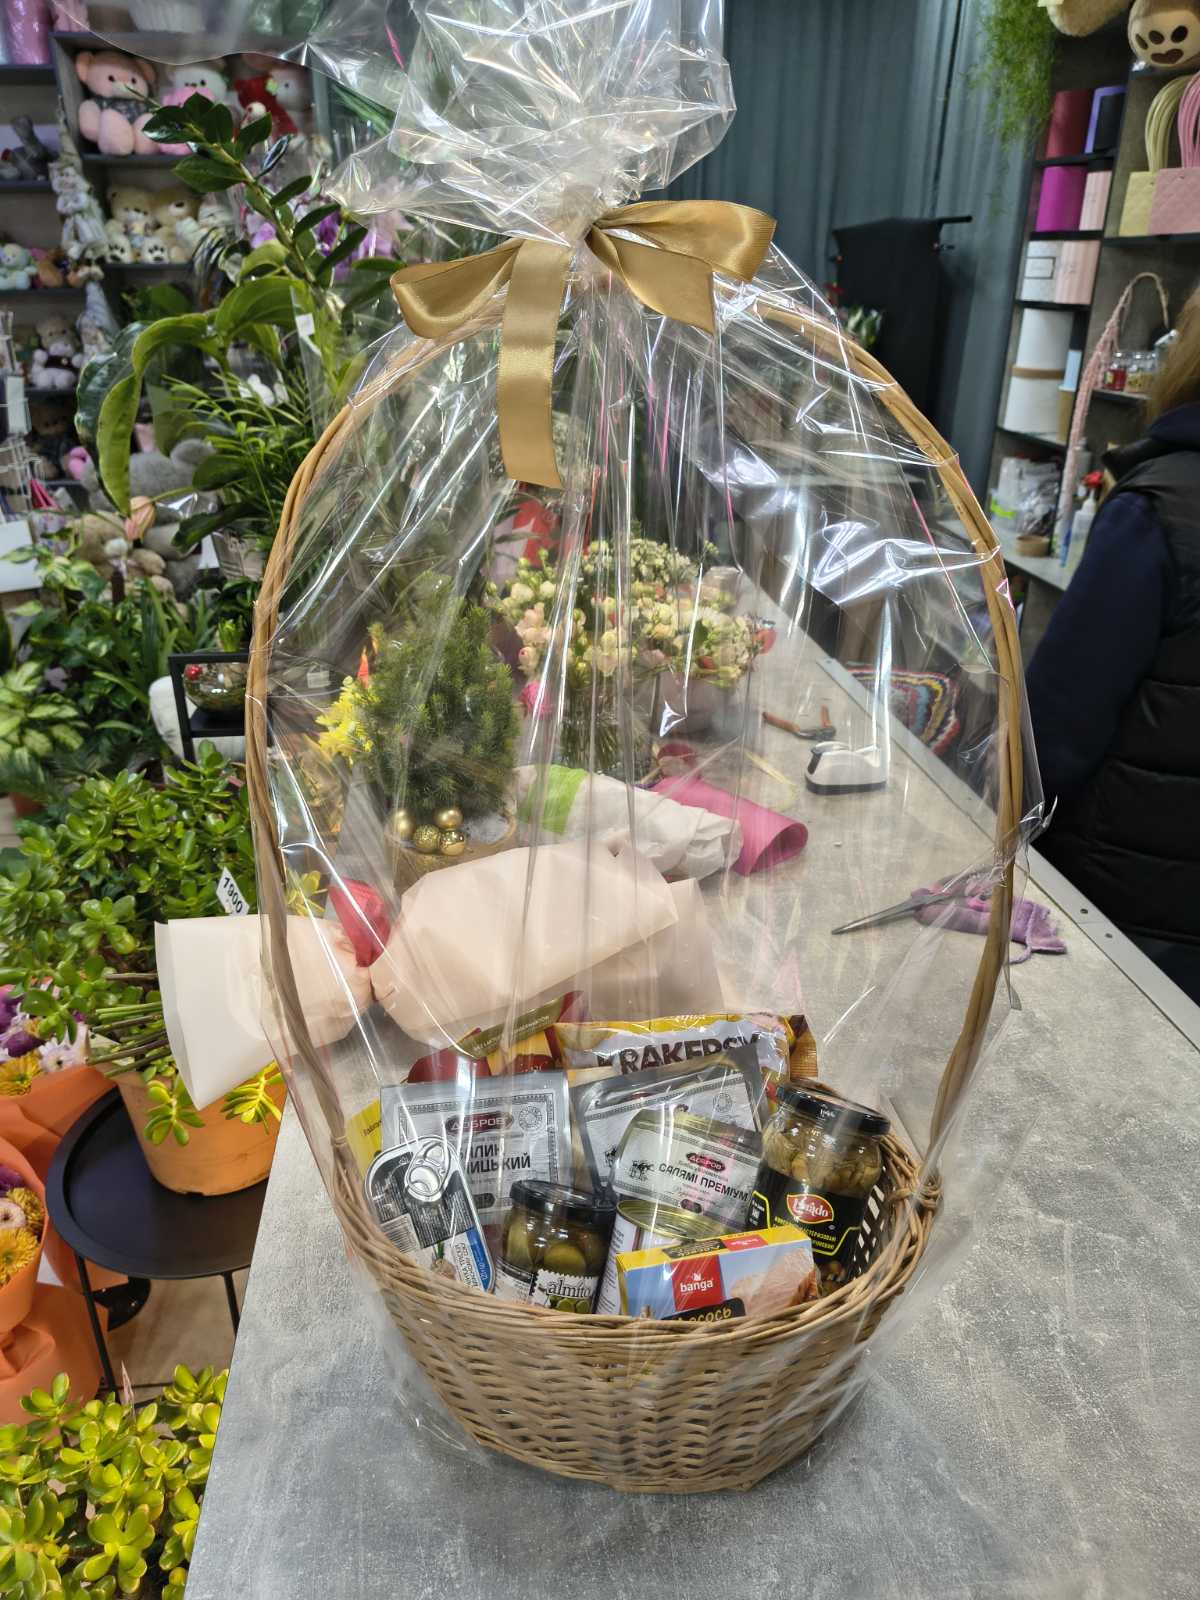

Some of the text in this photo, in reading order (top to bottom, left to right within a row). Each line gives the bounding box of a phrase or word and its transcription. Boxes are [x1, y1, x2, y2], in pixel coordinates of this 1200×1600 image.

[224, 877, 242, 913] 1900
[699, 1176, 749, 1202] ПРЕМІУМ
[679, 1278, 713, 1294] banga
